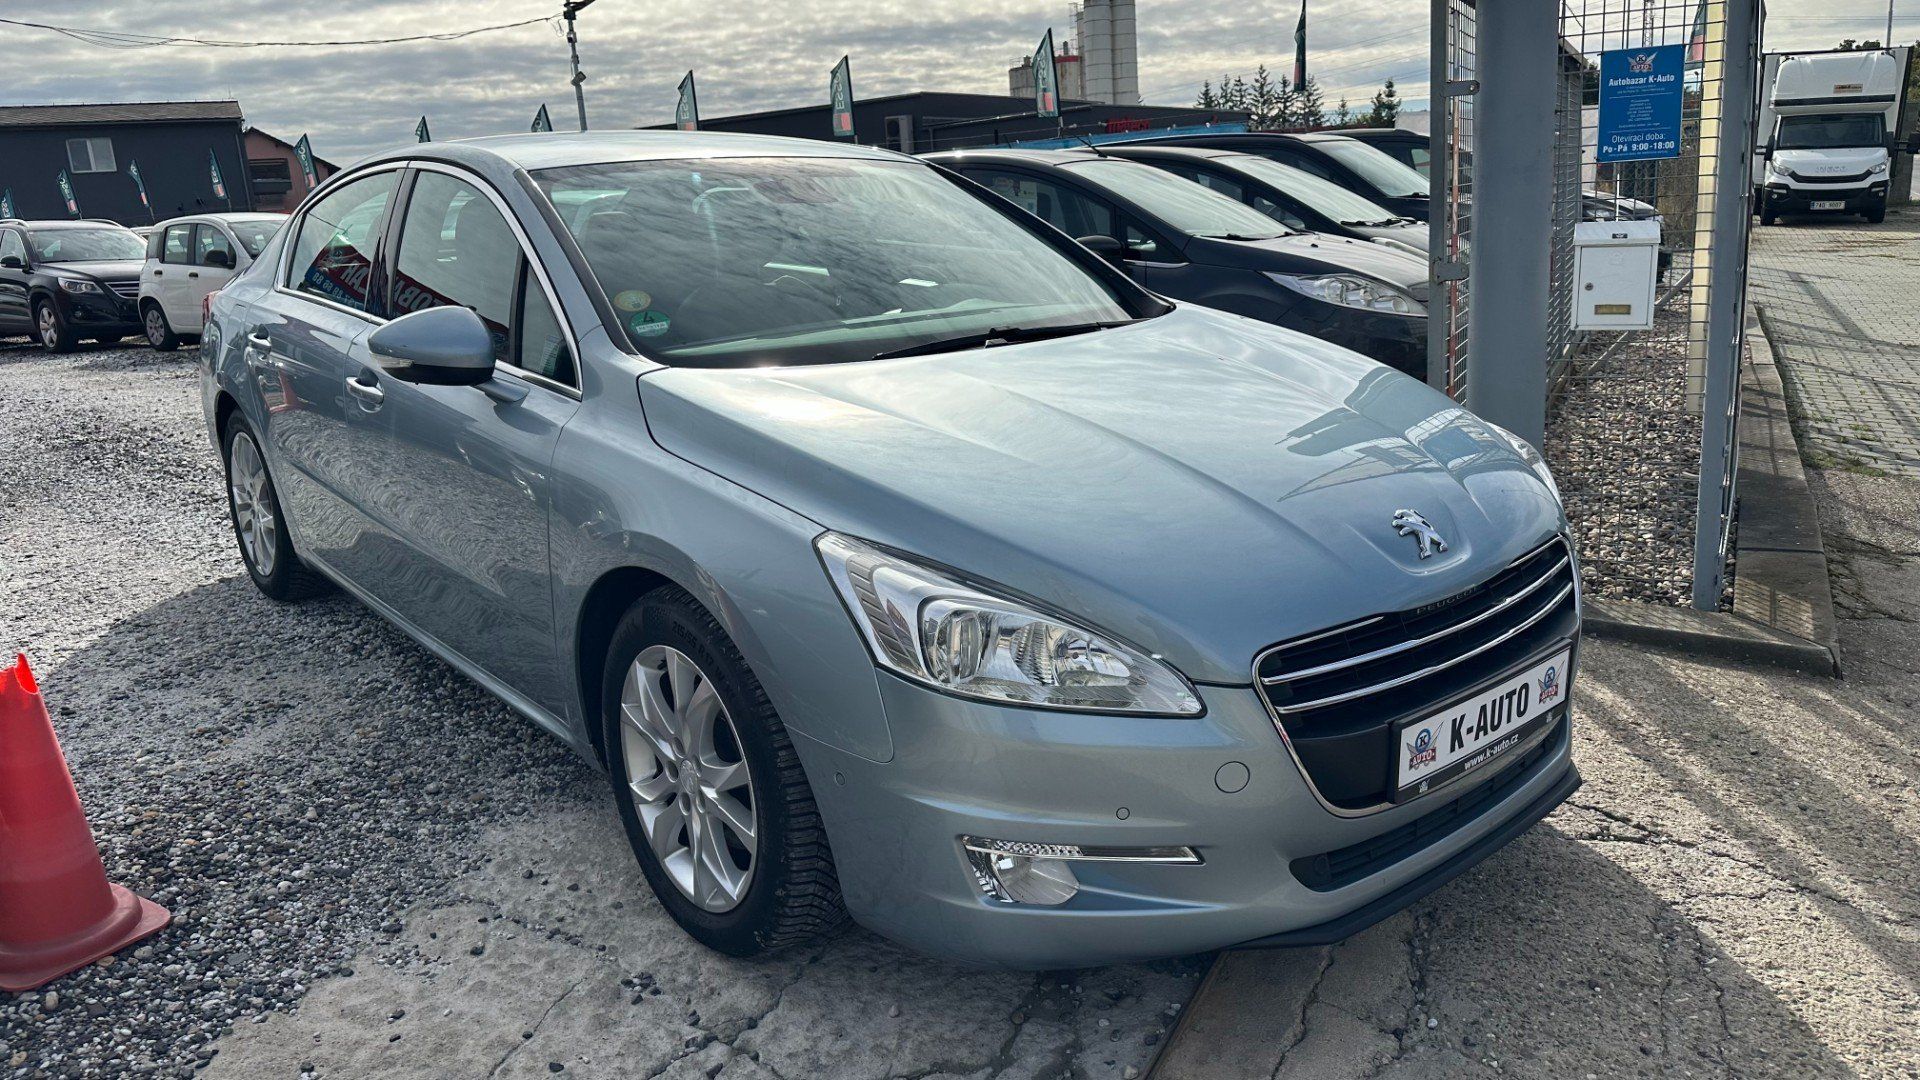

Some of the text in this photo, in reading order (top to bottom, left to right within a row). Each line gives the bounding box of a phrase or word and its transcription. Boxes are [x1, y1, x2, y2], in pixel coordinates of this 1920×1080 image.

[1609, 74, 1675, 86] Autobazar K-Auto
[1645, 132, 1666, 141] doba:
[1450, 682, 1530, 753] K-AUTO
[1419, 734, 1428, 748] K
[1412, 749, 1433, 765] AUTO
[1464, 733, 1519, 771] www.k-auto.cz
